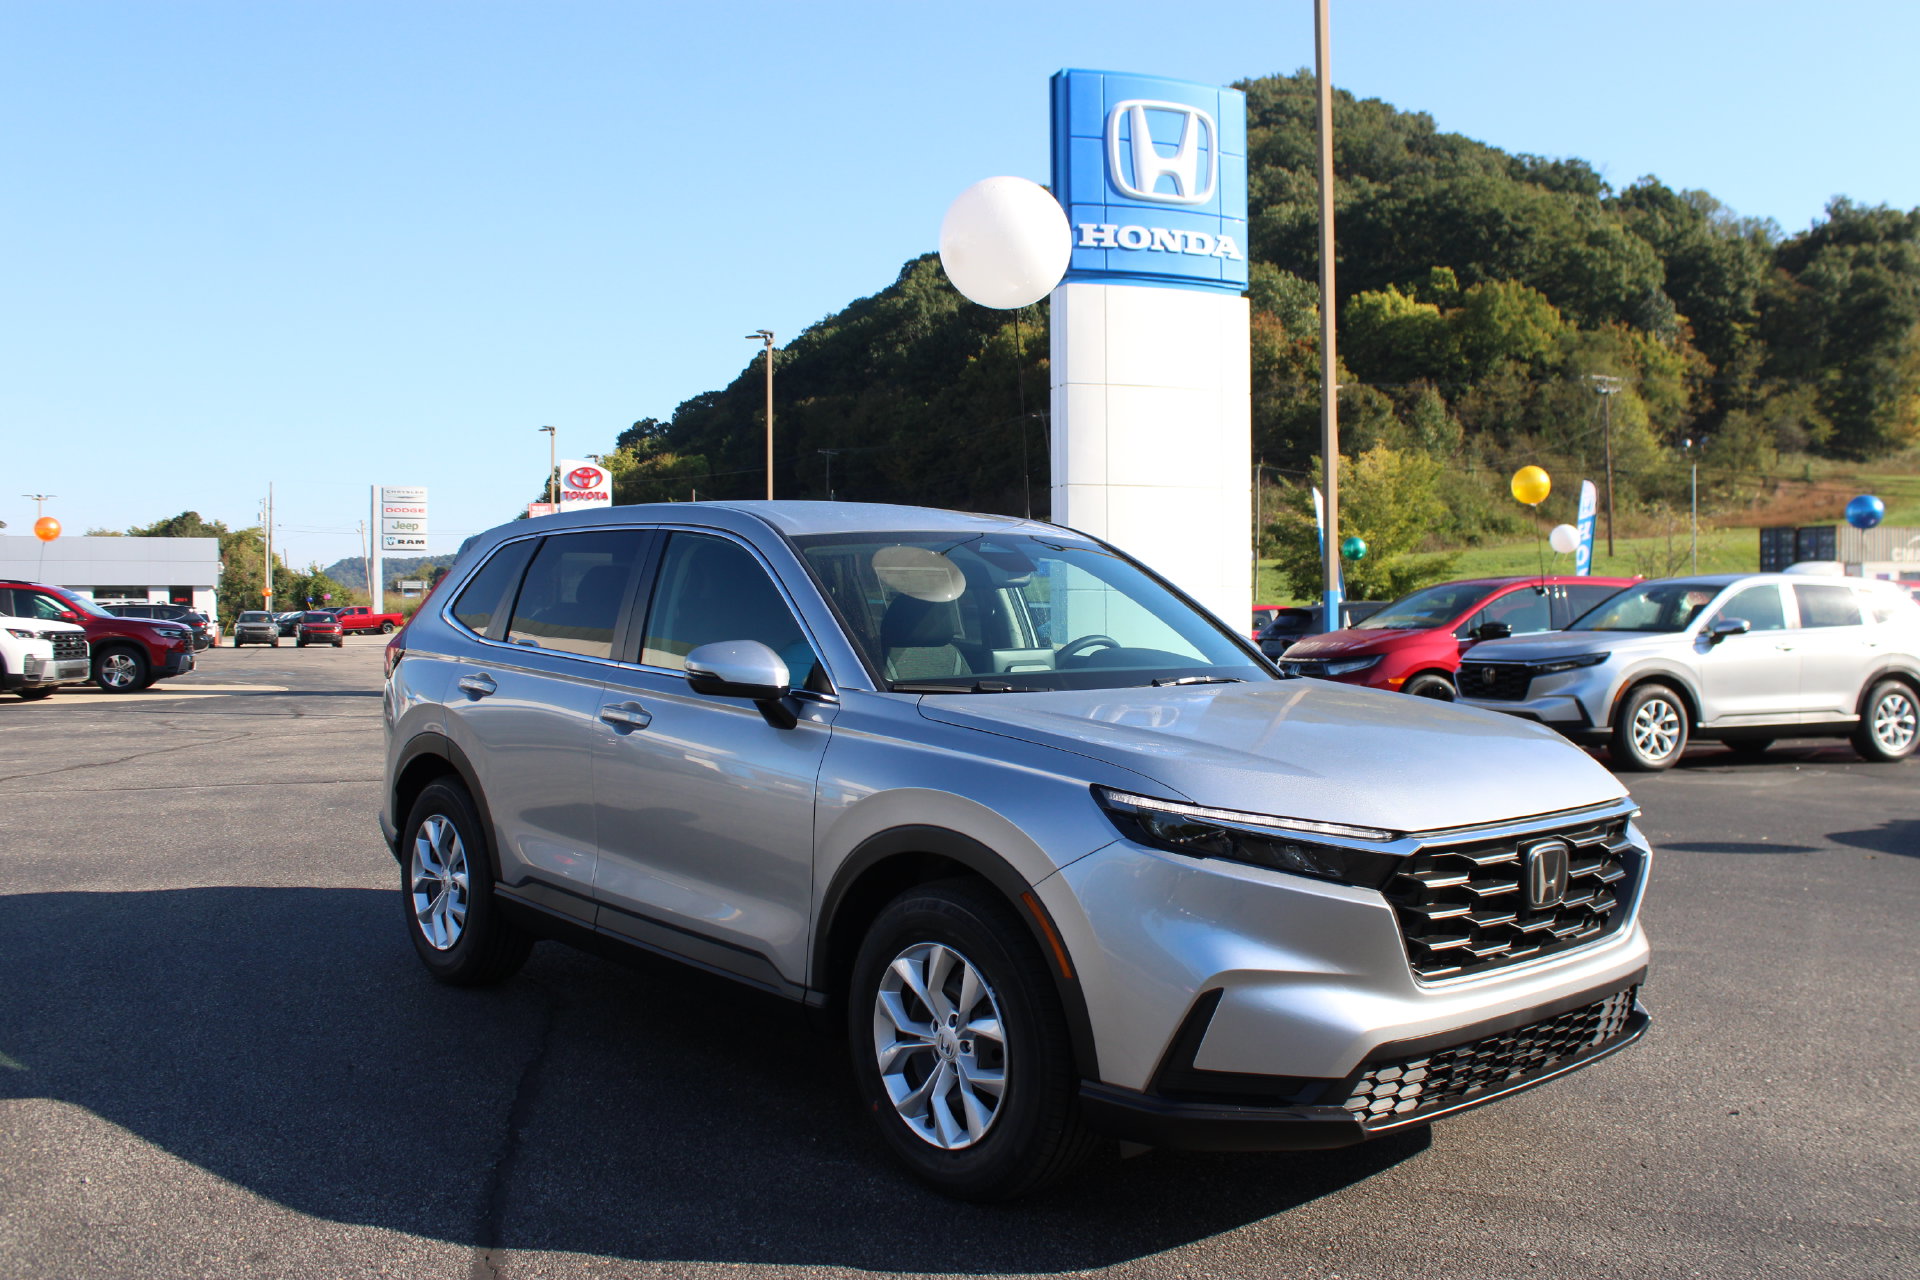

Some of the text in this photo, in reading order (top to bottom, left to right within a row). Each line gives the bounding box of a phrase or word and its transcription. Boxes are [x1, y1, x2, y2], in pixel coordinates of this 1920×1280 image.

[1078, 223, 1243, 259] HONDA
[564, 491, 608, 500] TOYOTA
[392, 520, 419, 531] Jeep
